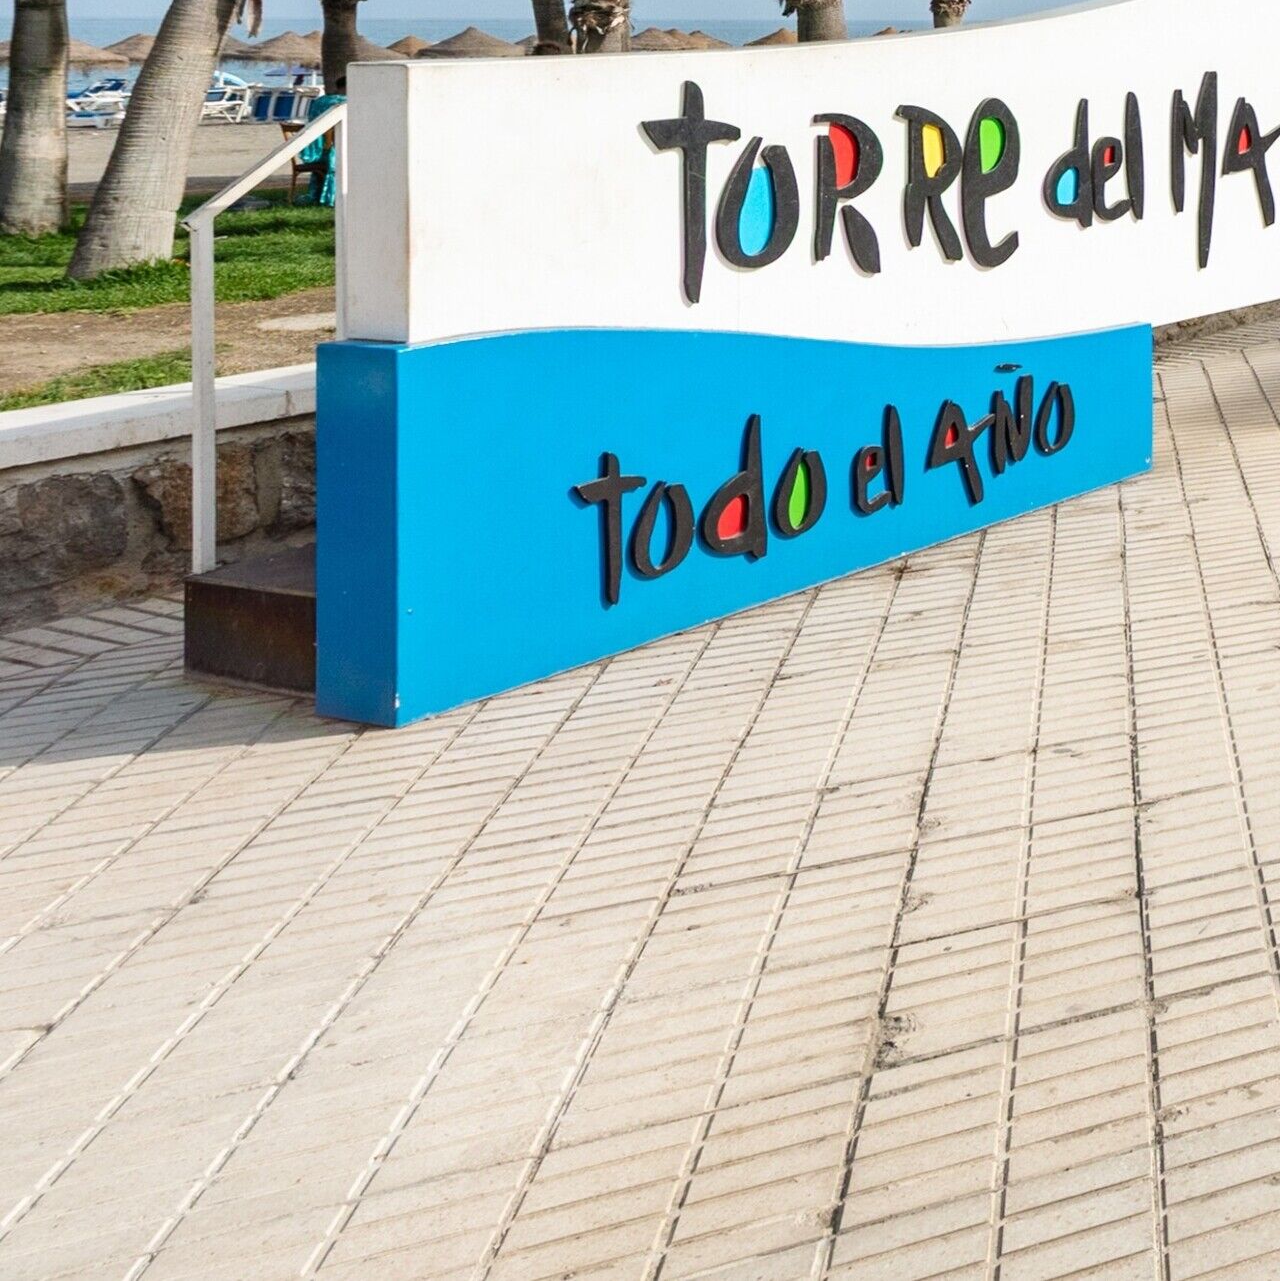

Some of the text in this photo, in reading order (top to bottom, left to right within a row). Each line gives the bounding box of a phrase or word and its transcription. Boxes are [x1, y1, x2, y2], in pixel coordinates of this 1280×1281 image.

[1043, 91, 1144, 228] del
[855, 404, 904, 515] el
[928, 363, 1076, 505] AÑO
